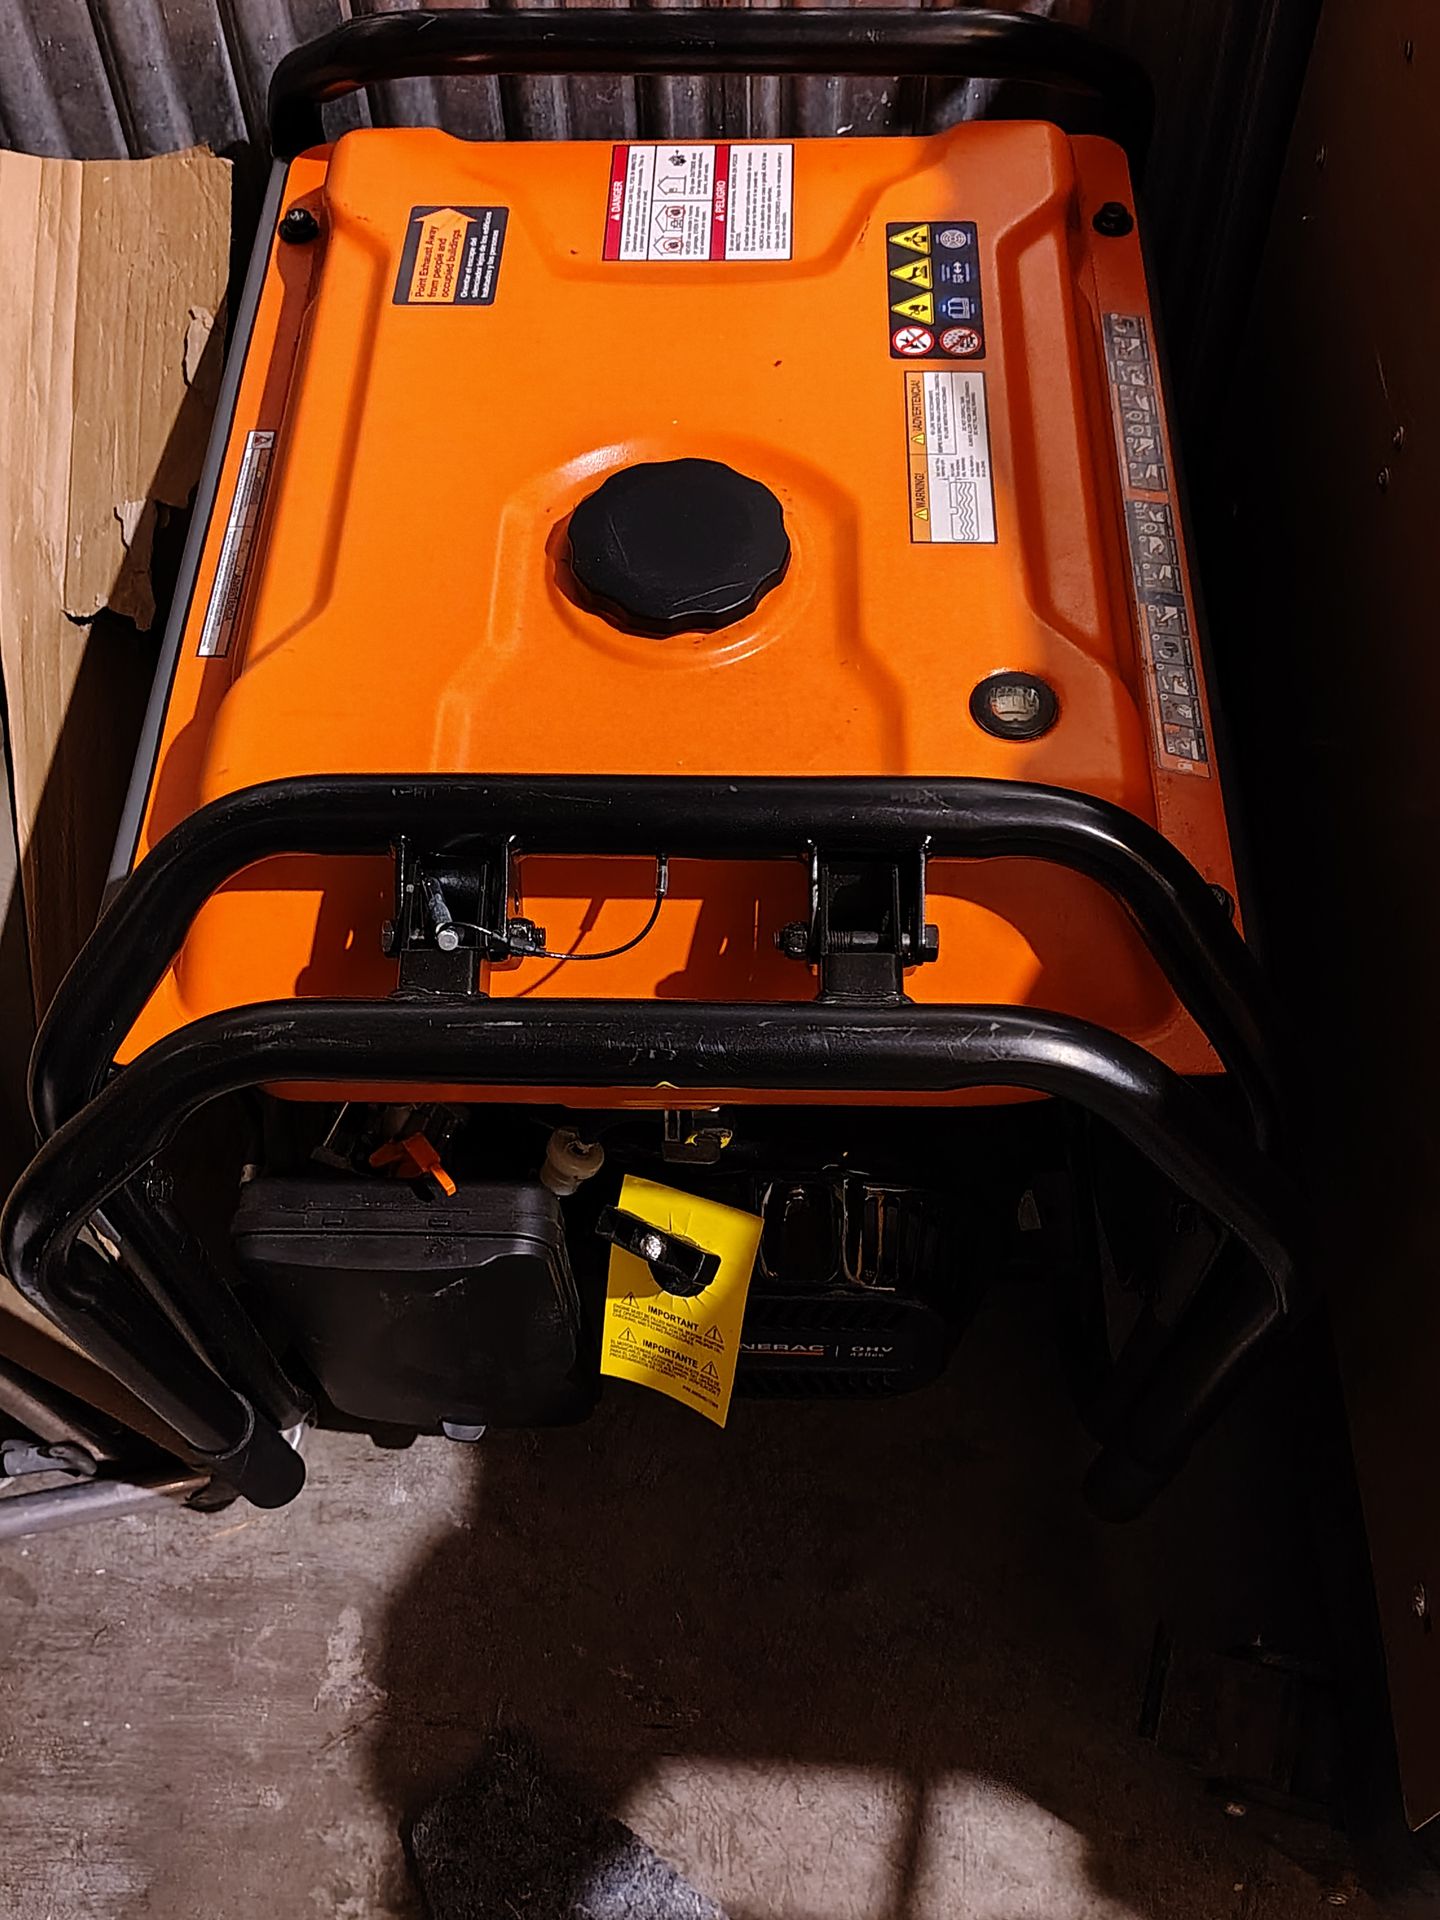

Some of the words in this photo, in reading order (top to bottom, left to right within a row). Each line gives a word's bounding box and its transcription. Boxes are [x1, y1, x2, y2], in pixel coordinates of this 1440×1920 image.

[612, 181, 622, 212] DANGER
[715, 181, 725, 213] PELIGRO
[426, 226, 438, 245] Away
[438, 238, 446, 251] and
[447, 230, 461, 262] buildings
[419, 247, 432, 276] Exhaust
[433, 254, 444, 278] people
[415, 278, 427, 297] Point
[428, 280, 438, 297] from
[442, 264, 454, 297] occupied
[910, 380, 923, 431] ¡ADVERTENCIA!
[914, 473, 926, 508] WARNING!
[648, 1305, 699, 1331] IMPORTANT
[643, 1339, 698, 1368] IMPORTANTE
[741, 1343, 824, 1351] NERAC
